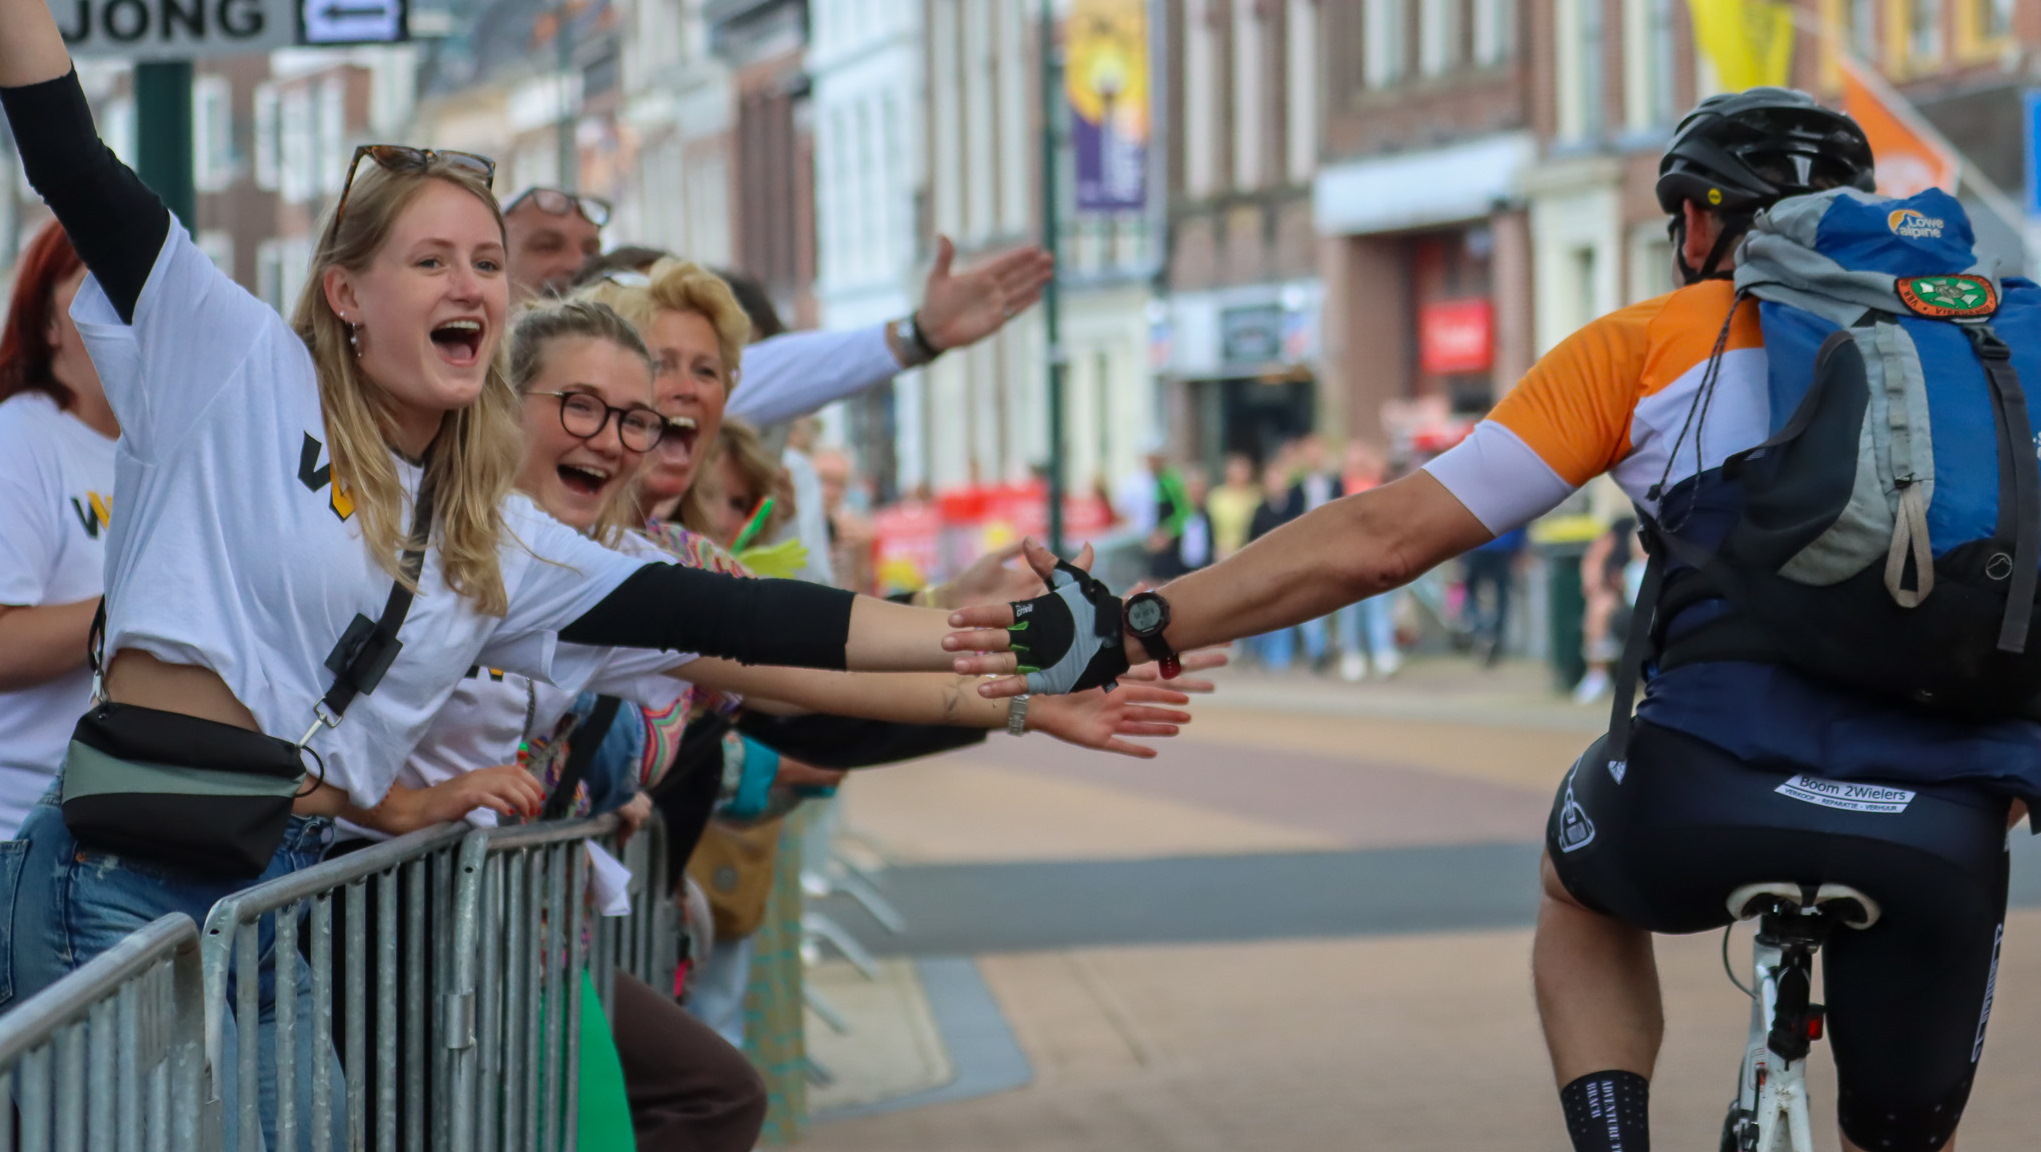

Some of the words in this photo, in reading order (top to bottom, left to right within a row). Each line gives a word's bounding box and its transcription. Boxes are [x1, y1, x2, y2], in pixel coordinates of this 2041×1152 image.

[62, 0, 266, 43] JONG
[1899, 227, 1942, 240] alpine
[1907, 216, 1944, 229] Lowe
[1785, 787, 1816, 801] VERKOOP
[1821, 798, 1858, 810] REPARATIE
[1799, 776, 1840, 796] Boom
[1844, 785, 1907, 801] 2Wielers
[1601, 1081, 1620, 1141] ADVENTURE
